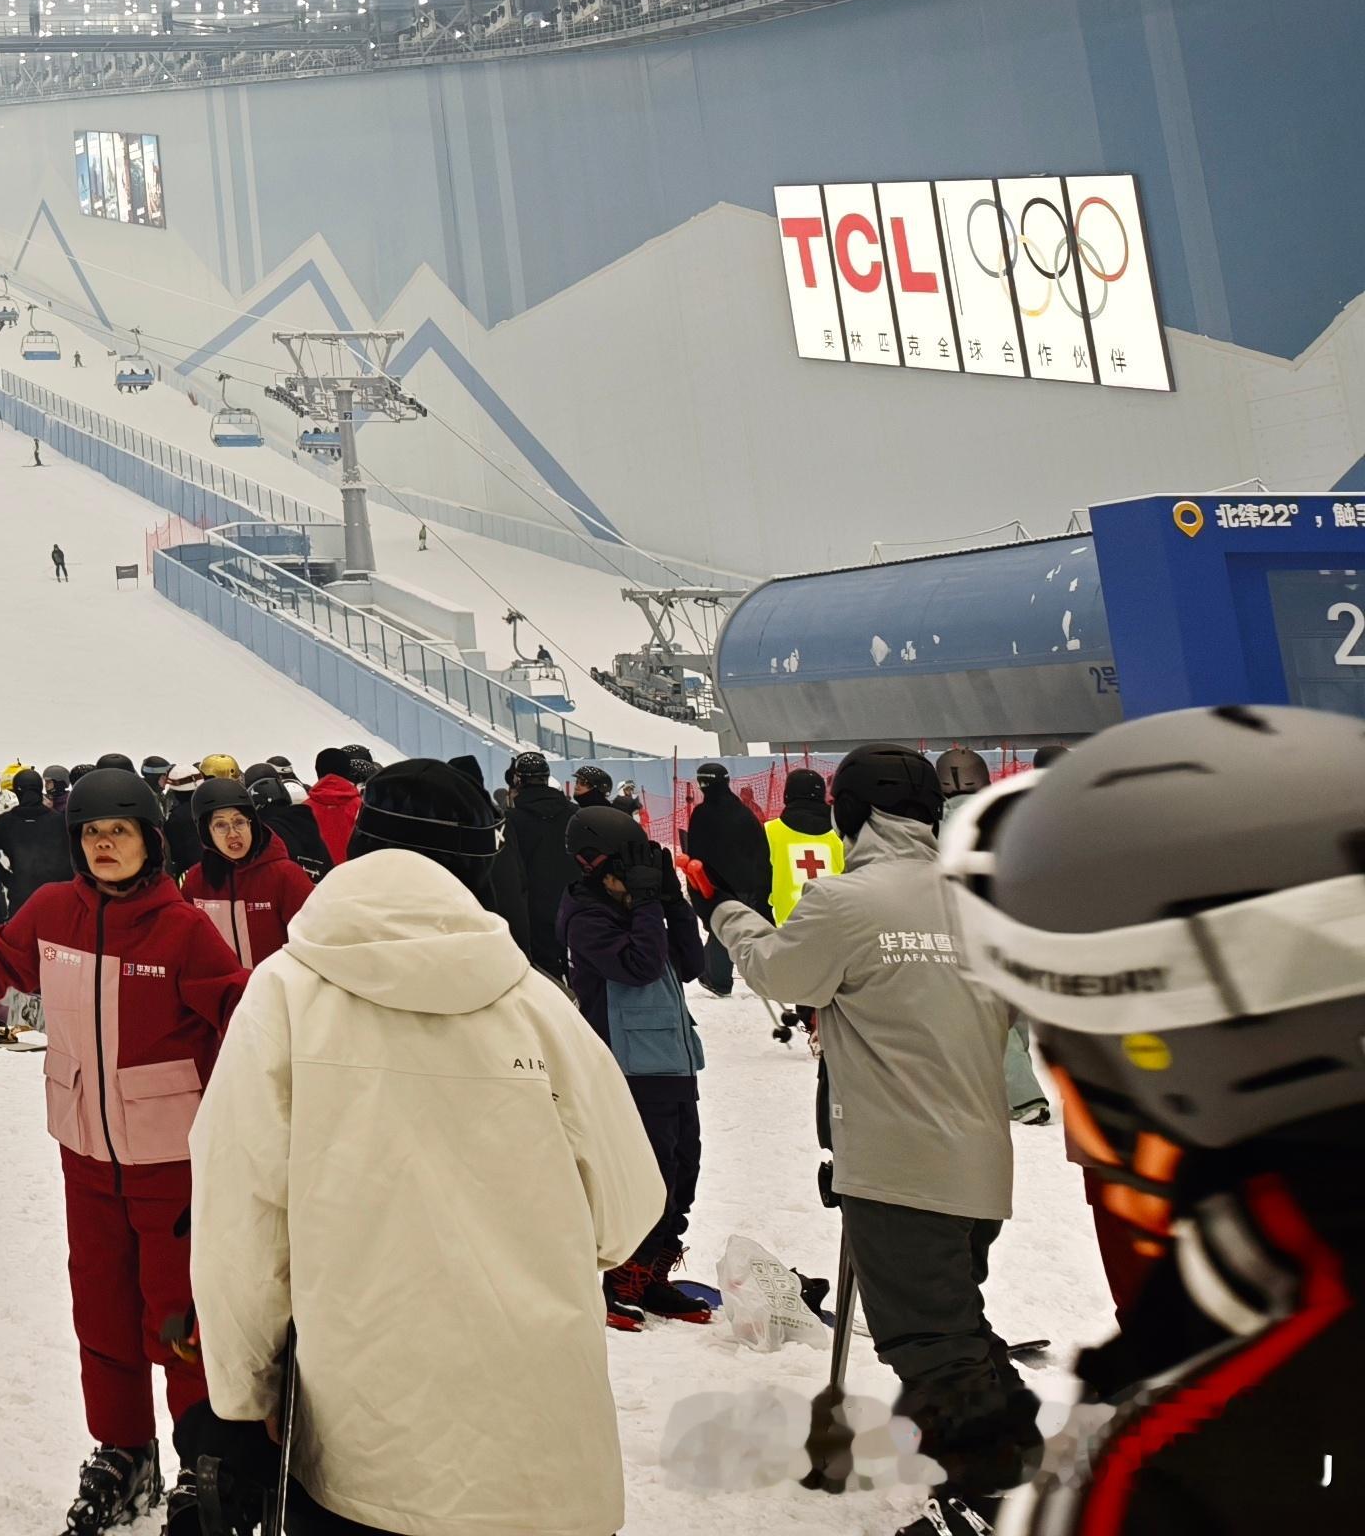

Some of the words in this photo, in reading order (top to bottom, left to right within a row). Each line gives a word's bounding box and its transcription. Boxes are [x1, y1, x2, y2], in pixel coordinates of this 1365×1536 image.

[780, 212, 940, 294] TCL
[823, 329, 1128, 372] 奥林匹克全球合作伙伴
[882, 953, 929, 965] HUAFA
[933, 954, 958, 964] SNO
